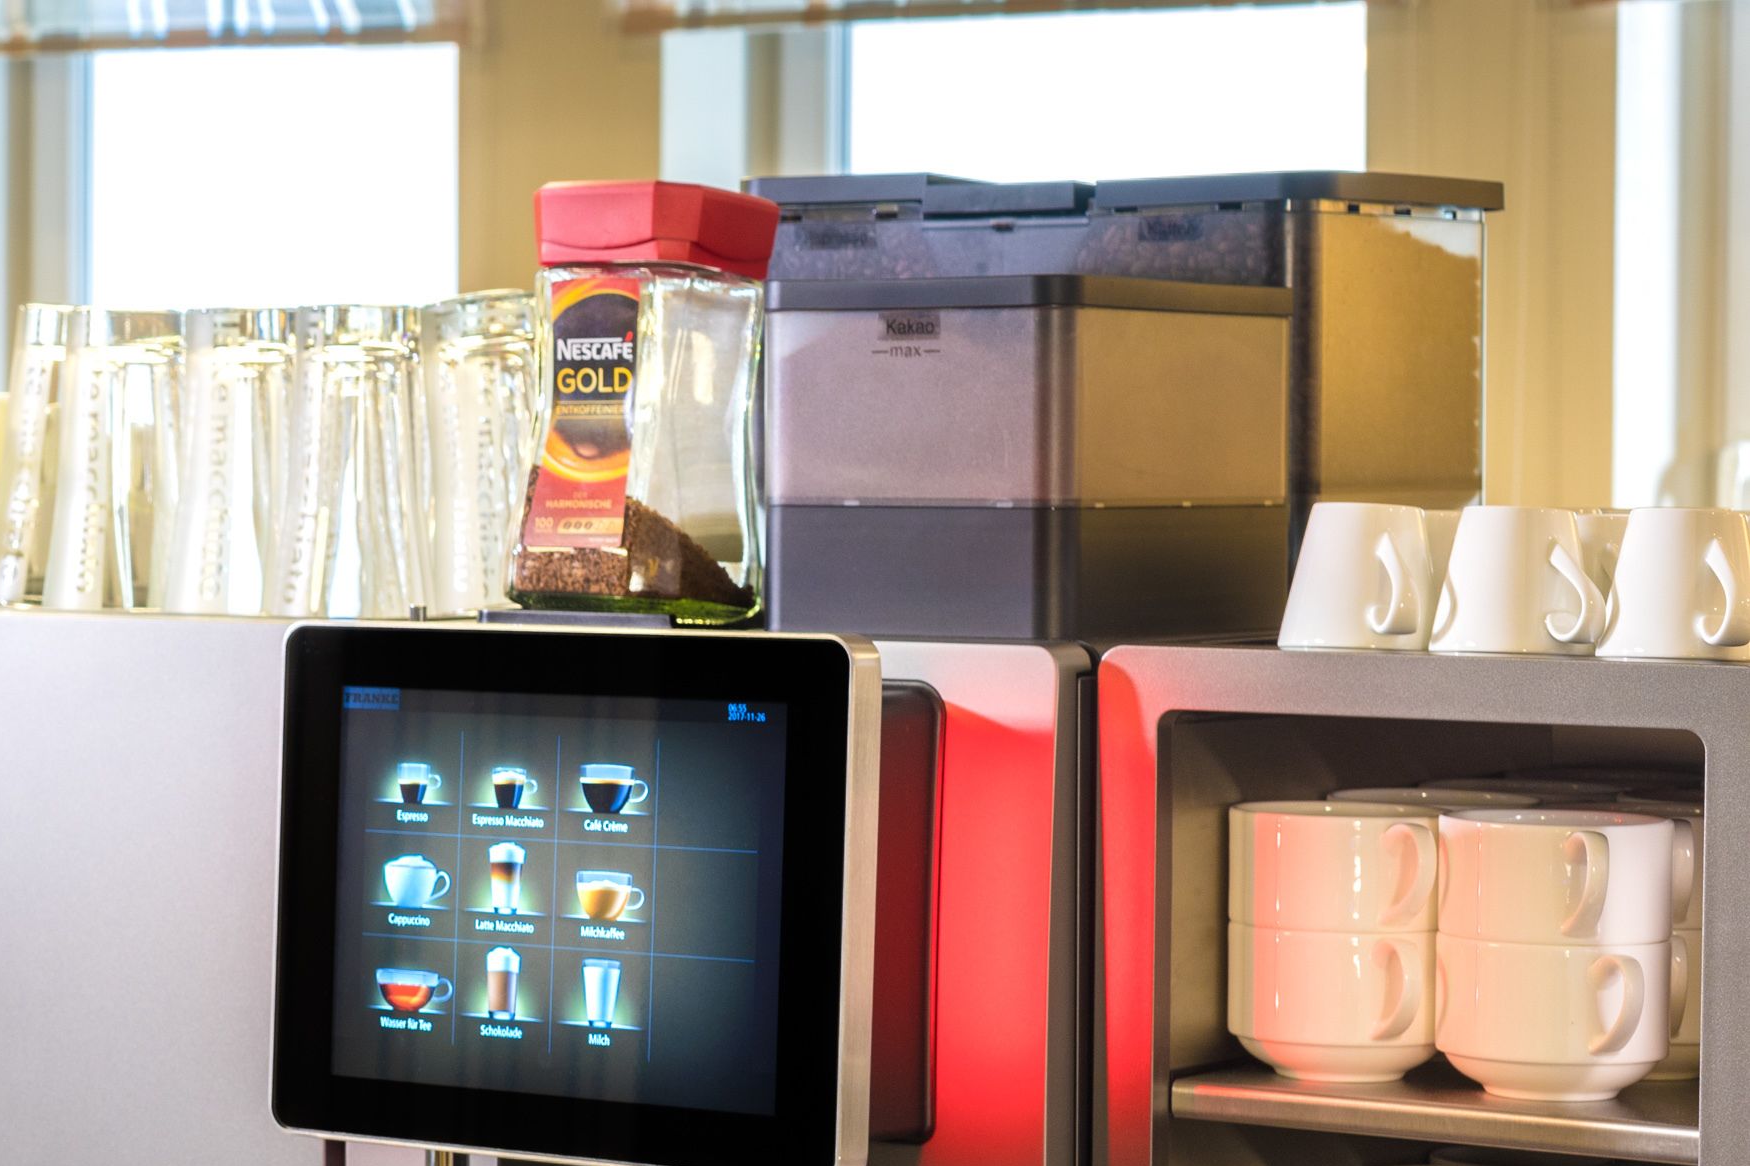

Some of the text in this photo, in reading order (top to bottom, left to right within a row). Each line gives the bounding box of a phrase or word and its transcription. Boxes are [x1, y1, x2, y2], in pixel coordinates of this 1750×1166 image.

[886, 319, 935, 335] Kakao
[556, 331, 634, 361] NESCAFÉ
[890, 346, 921, 357] max
[556, 367, 633, 394] GOLD
[397, 810, 428, 822] Espresso
[472, 814, 544, 828] Espresso Macchiato
[584, 819, 628, 832] Café Crème
[388, 913, 430, 927] Cappuccino
[475, 919, 534, 934] Latte Macchiato
[580, 926, 625, 940] Milchkaffee
[380, 1016, 432, 1031] Wasser für Tee
[480, 1024, 522, 1039] Schokolade
[588, 1033, 610, 1046] Milch
